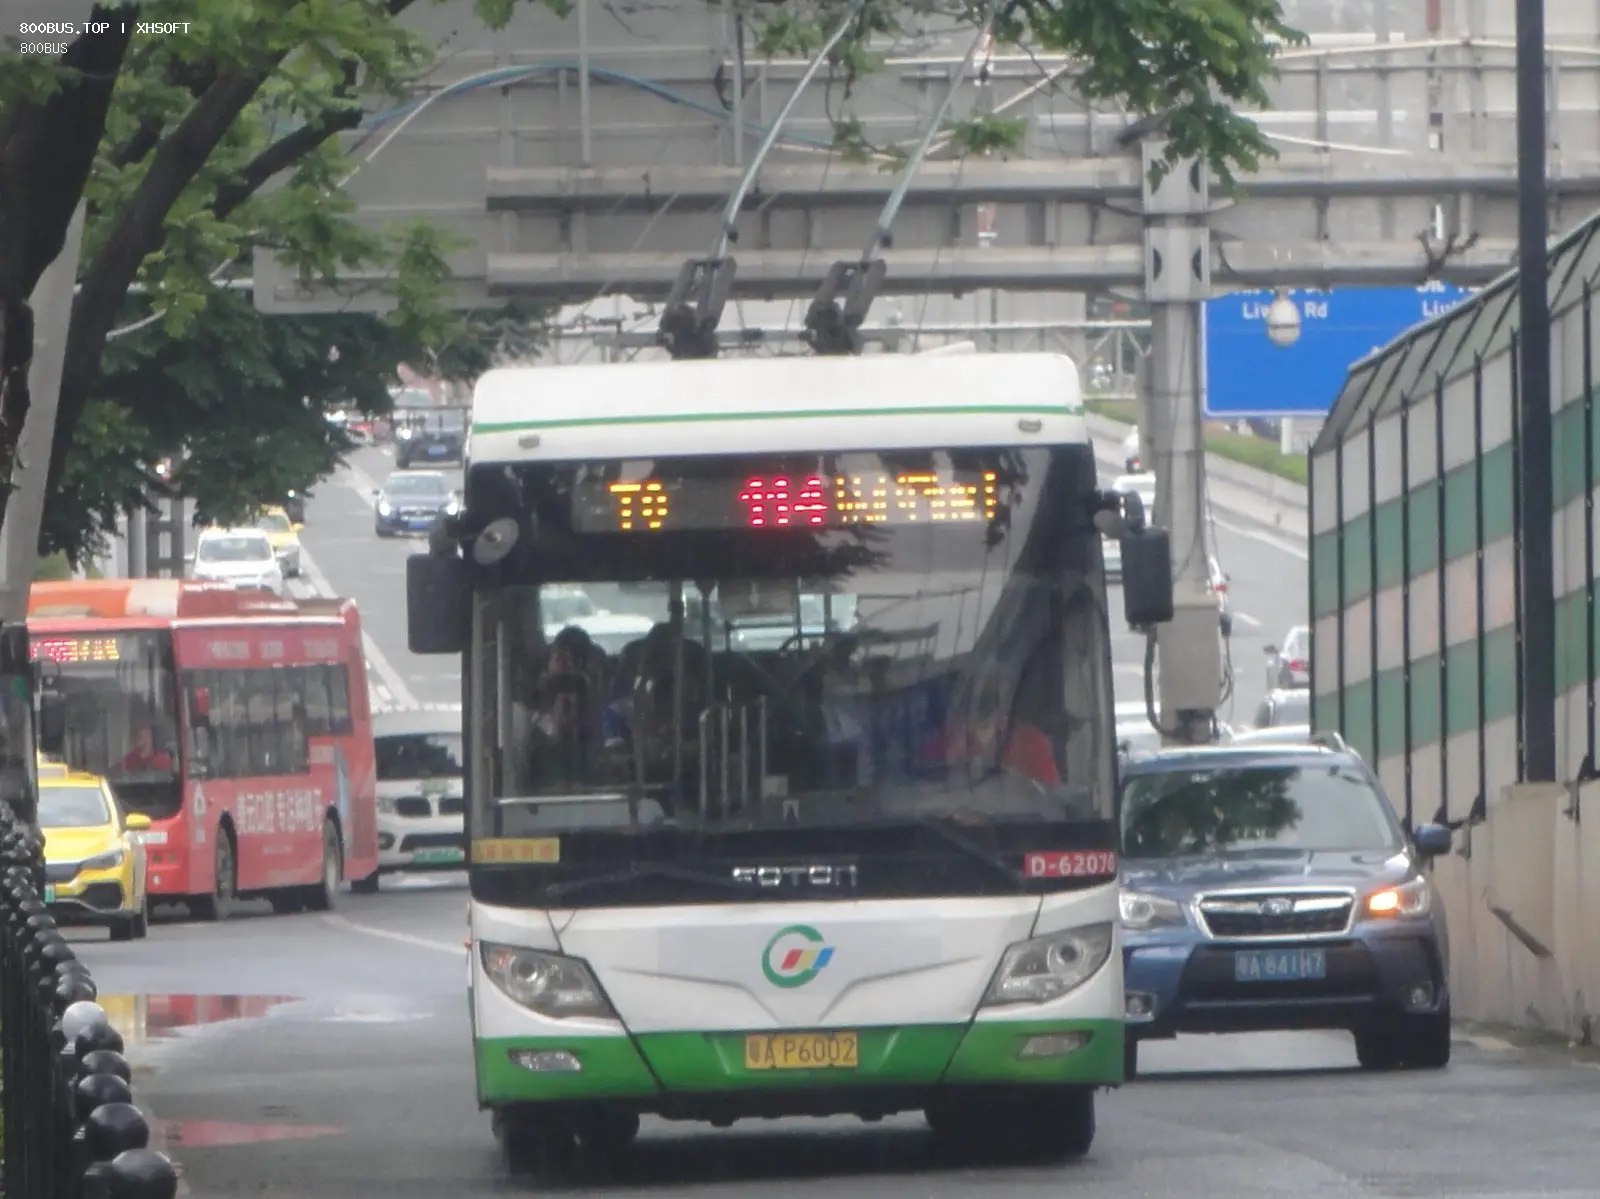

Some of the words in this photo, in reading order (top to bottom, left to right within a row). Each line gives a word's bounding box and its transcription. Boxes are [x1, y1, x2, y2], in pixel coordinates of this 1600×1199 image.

[1304, 301, 1328, 319] Rd
[739, 477, 829, 527] 114
[731, 864, 858, 887] FOTON
